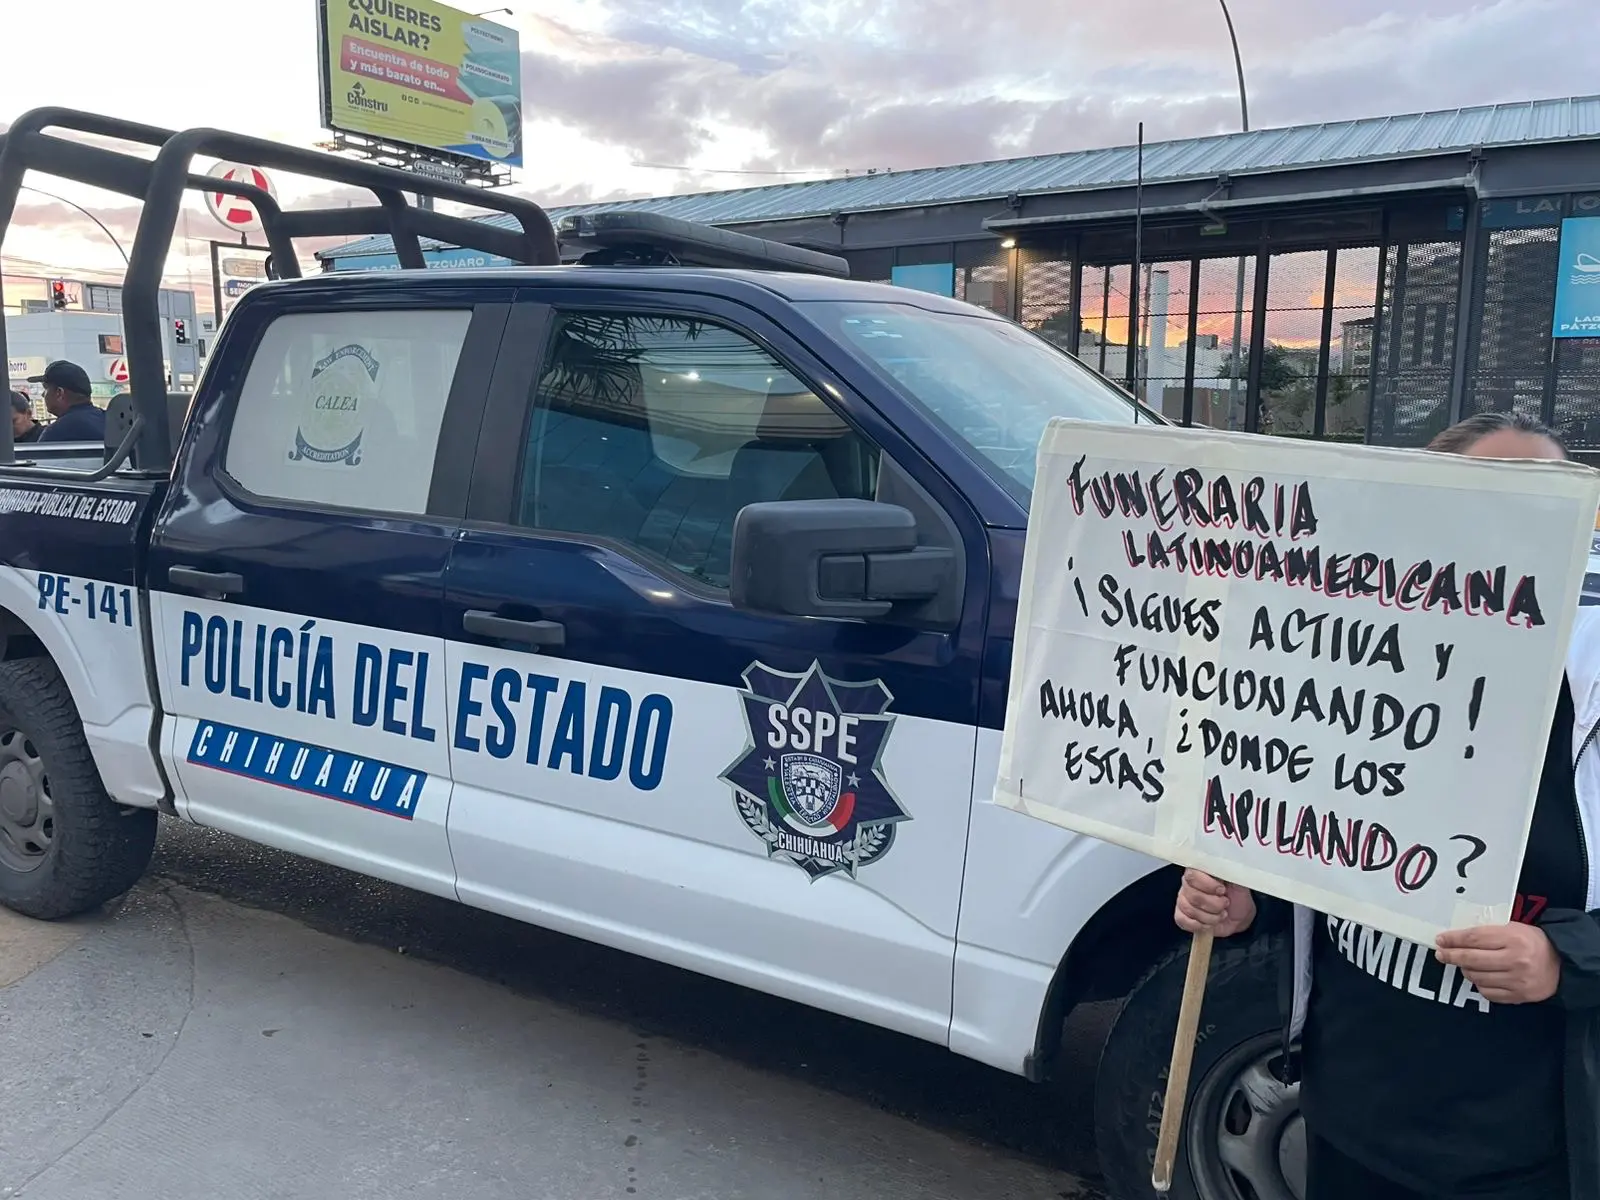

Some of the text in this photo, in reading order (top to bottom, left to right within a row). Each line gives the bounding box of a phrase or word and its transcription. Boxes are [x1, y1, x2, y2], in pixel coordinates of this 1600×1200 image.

[349, 13, 430, 51] AISLAR?
[350, 42, 449, 79] Encuentra de todo
[350, 59, 445, 93] y más barato en...
[427, 257, 485, 270] TZCUARO
[315, 395, 358, 411] CALEA
[35, 488, 79, 518] PÚBLICA
[74, 496, 97, 520] DEL
[93, 498, 137, 524] ESTADO
[1067, 454, 1318, 541] FUNERARIA
[38, 573, 132, 627] PE-141
[1122, 530, 1545, 629] LATINOAMERICANA
[1249, 605, 1405, 673] ACTIVA
[181, 610, 673, 791] POLICÍA DEL ESTADO
[768, 703, 859, 765] SSPE
[195, 725, 417, 810] CHIHUAHUA
[1335, 753, 1406, 796] LOS
[778, 831, 844, 863] CHIHUAHUA
[1326, 914, 1490, 1014] FAMILIA
